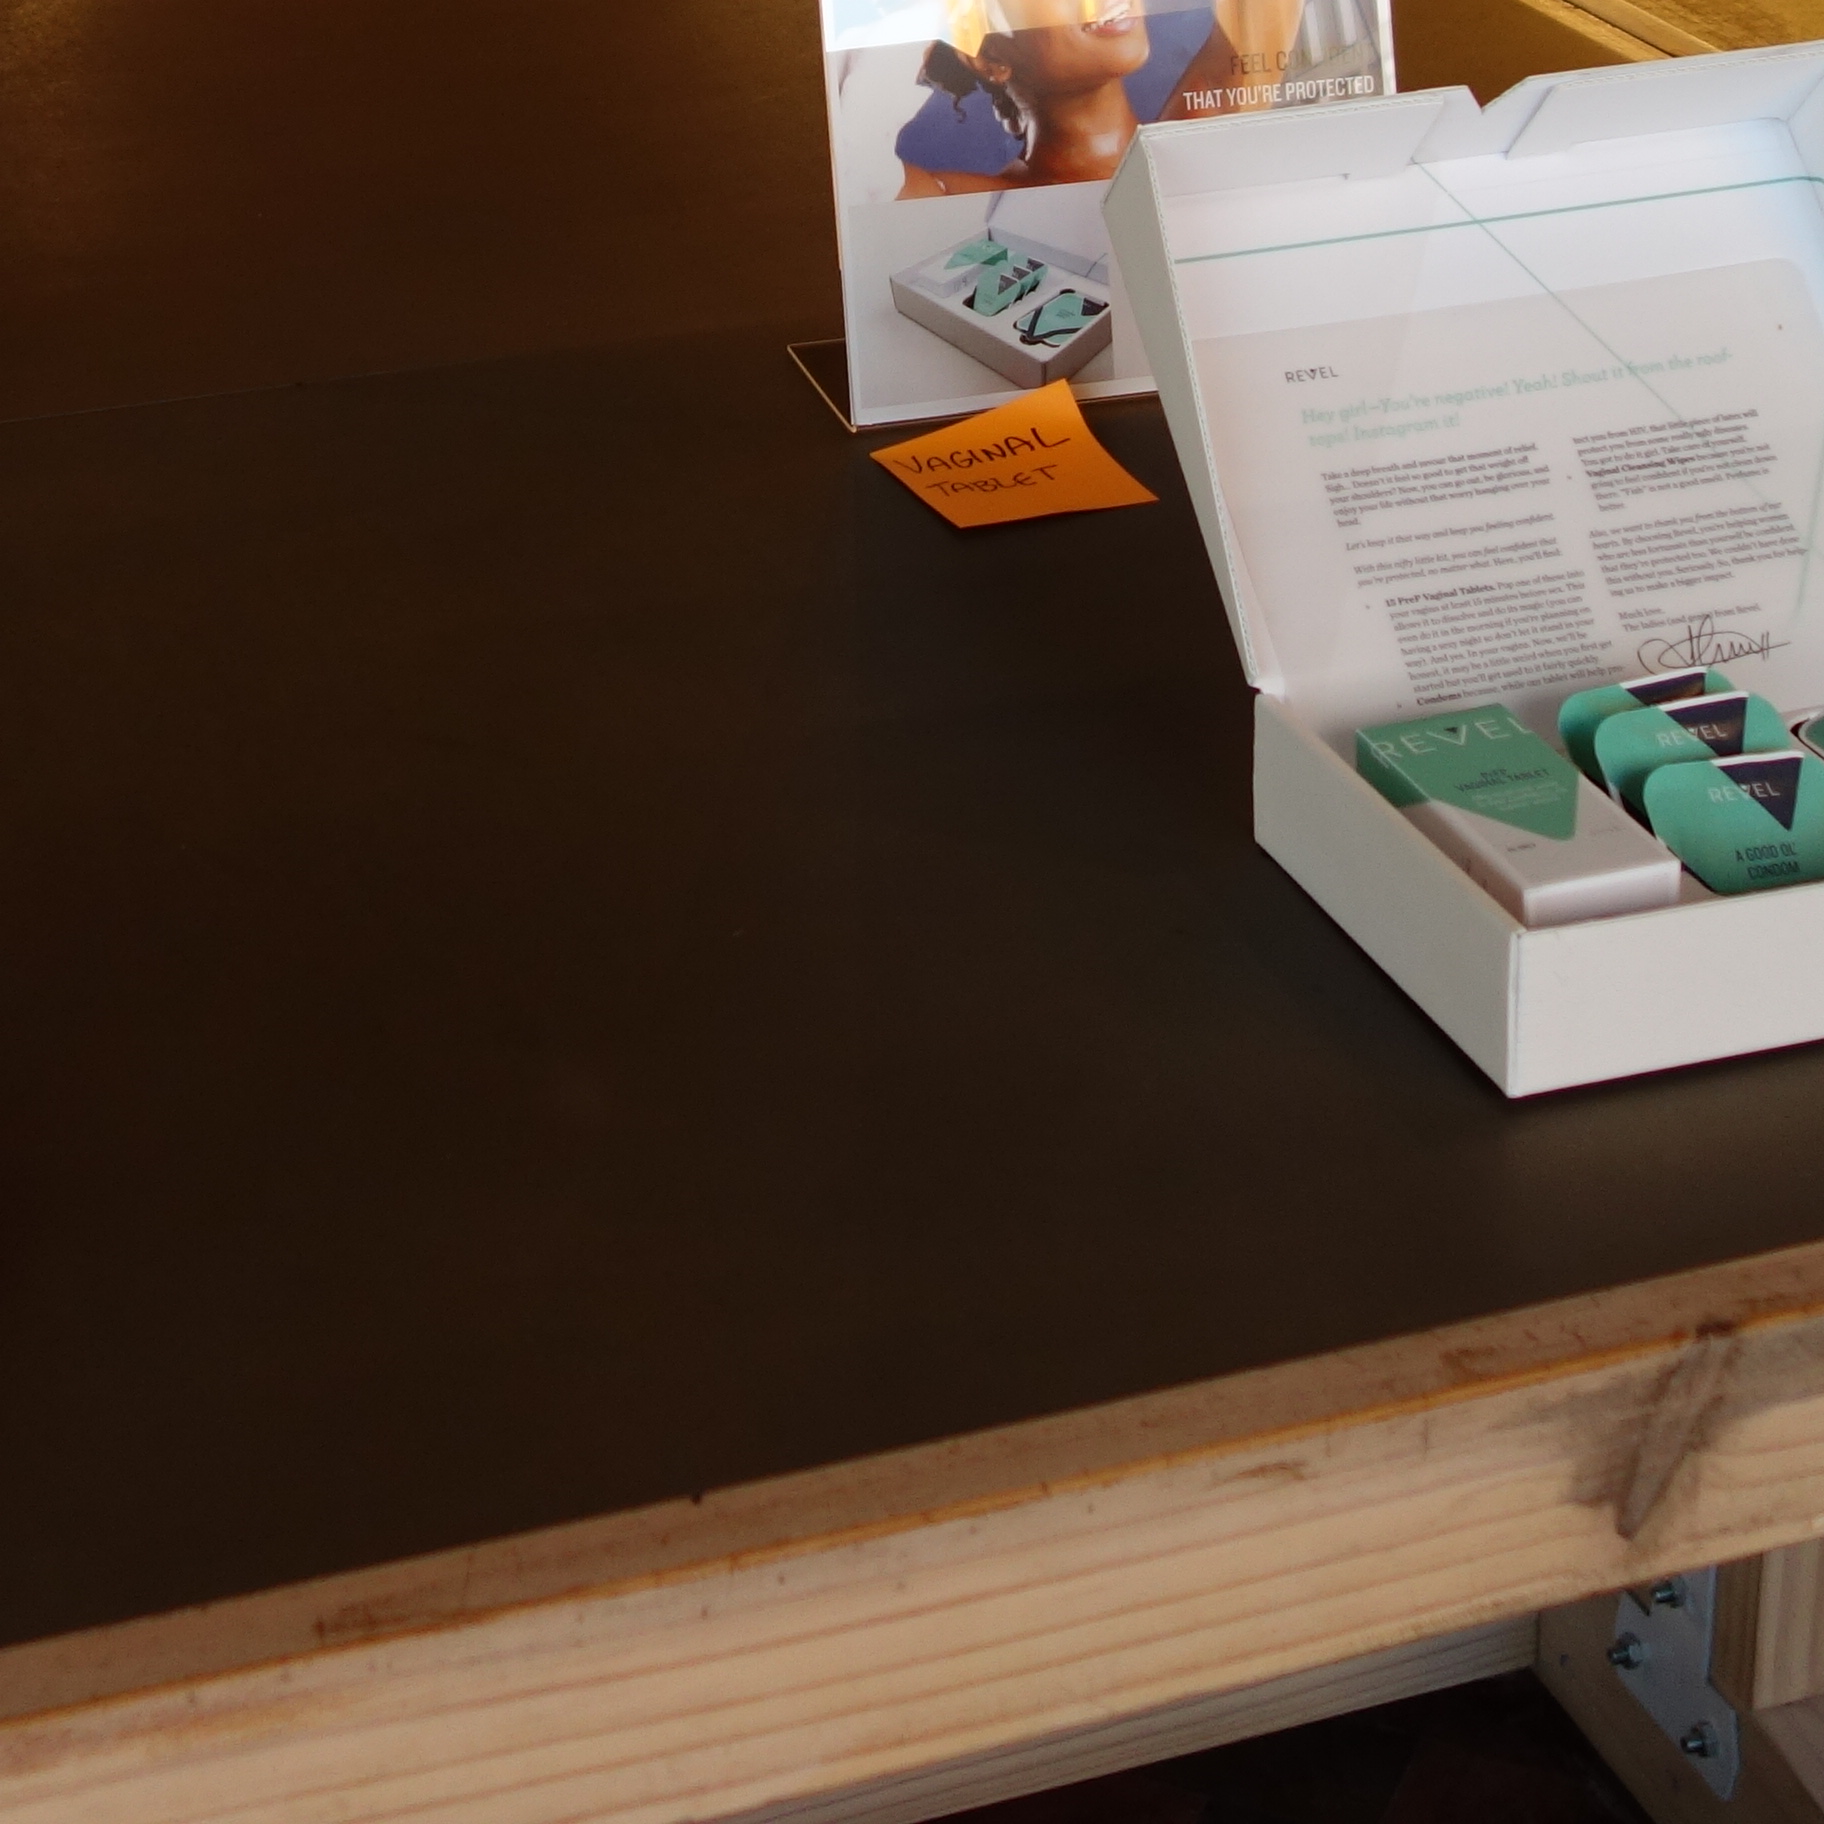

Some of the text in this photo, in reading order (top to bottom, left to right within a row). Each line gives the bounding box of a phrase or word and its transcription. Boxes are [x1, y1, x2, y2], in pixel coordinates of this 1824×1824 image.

[1230, 52, 1272, 76] FEEL
[1183, 75, 1375, 111] THAT YOU'RE PROTECTED
[1284, 365, 1339, 384] REVEL
[894, 427, 1071, 475] VAGINAL
[927, 464, 1058, 497] TABLET
[1585, 464, 1619, 479] Vaginal
[1422, 587, 1458, 603] Vaginal
[1416, 690, 1461, 705] Condoms
[1371, 717, 1535, 769] REVEL
[1655, 723, 1727, 748] REVEL
[1708, 781, 1781, 803] REVEL
[1736, 849, 1745, 862] A
[1745, 844, 1779, 861] GOOD
[1747, 861, 1800, 880] CONDOM
